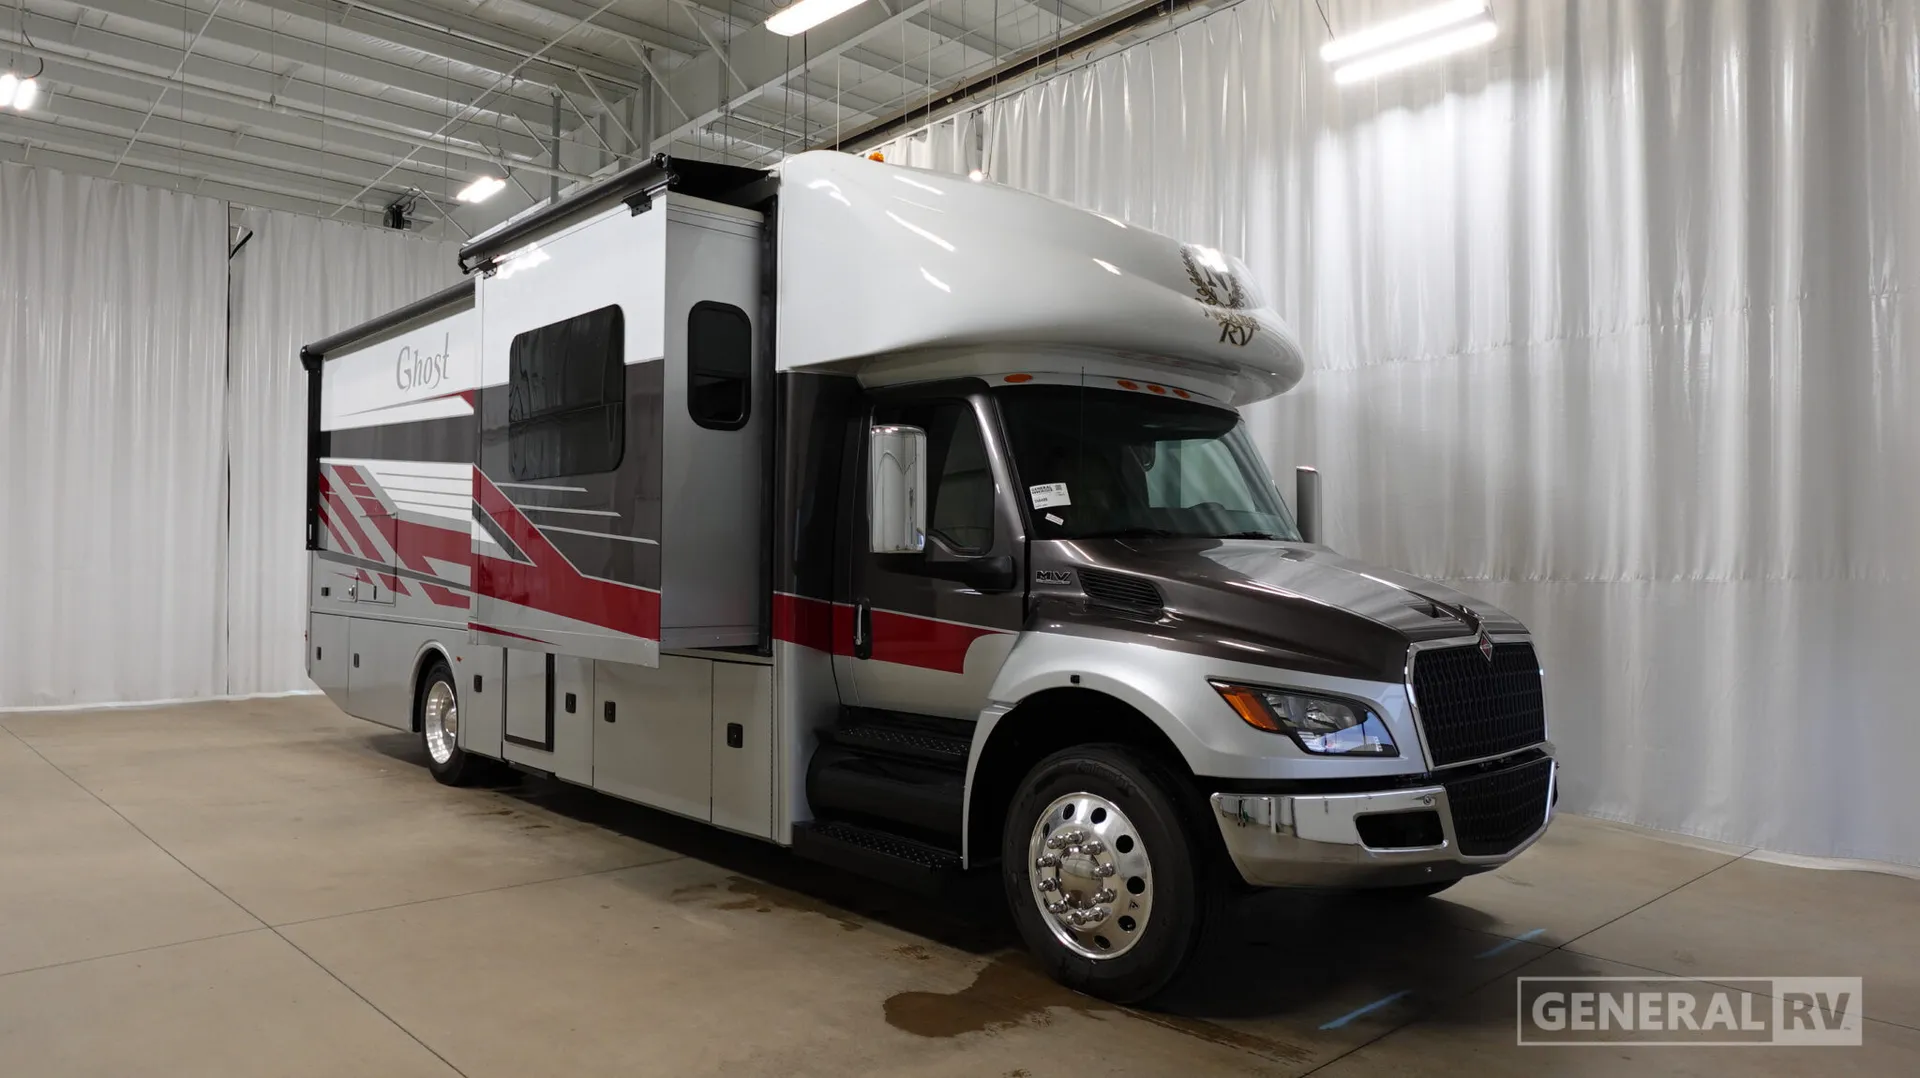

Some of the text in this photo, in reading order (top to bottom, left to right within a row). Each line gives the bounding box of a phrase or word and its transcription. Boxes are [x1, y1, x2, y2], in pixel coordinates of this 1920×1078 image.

[1218, 320, 1255, 347] RV
[396, 331, 450, 392] Ghost
[1035, 570, 1072, 582] MV
